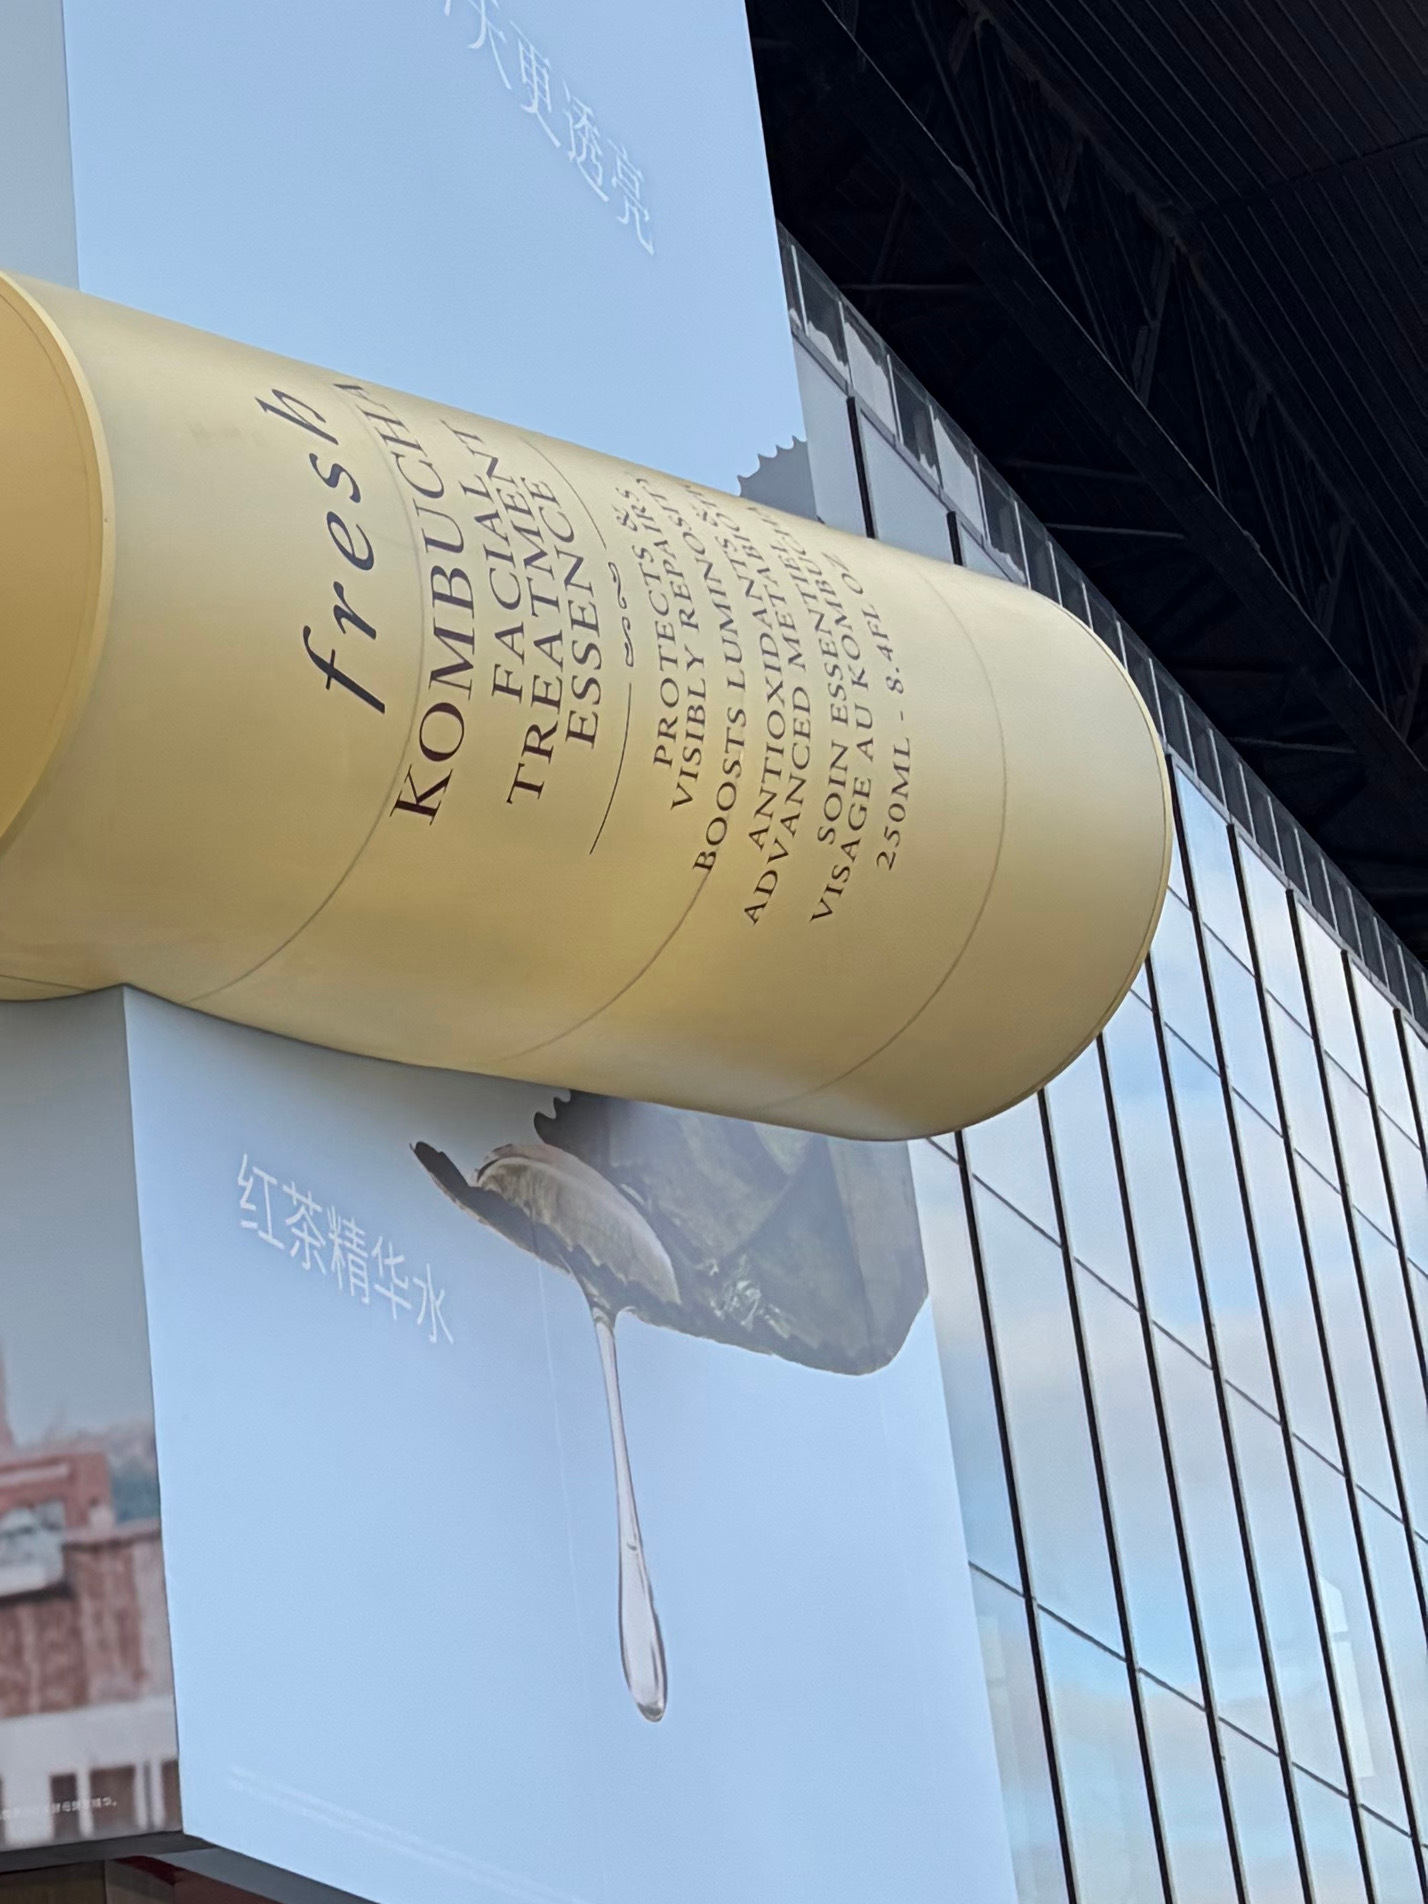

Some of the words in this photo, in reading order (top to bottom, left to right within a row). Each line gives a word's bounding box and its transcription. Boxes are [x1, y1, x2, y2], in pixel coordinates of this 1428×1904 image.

[253, 387, 386, 715] fresh
[332, 382, 477, 827] KOMBUCHA
[443, 421, 564, 805] TREATMENT
[458, 474, 525, 704] FACIAL
[519, 477, 603, 749] ESSENCE
[631, 544, 680, 768] PROTECTS
[670, 644, 707, 811] VISIBLY
[692, 706, 747, 872] BOOSTS
[714, 535, 787, 851] ANTIOXIDANTS
[743, 686, 811, 925] ADVANCED
[817, 740, 849, 846] SOIN
[876, 736, 911, 872] 250ML
[809, 776, 872, 923] VISAGE
[853, 702, 875, 762] AU
[236, 1153, 454, 1346] 红茶精华水
